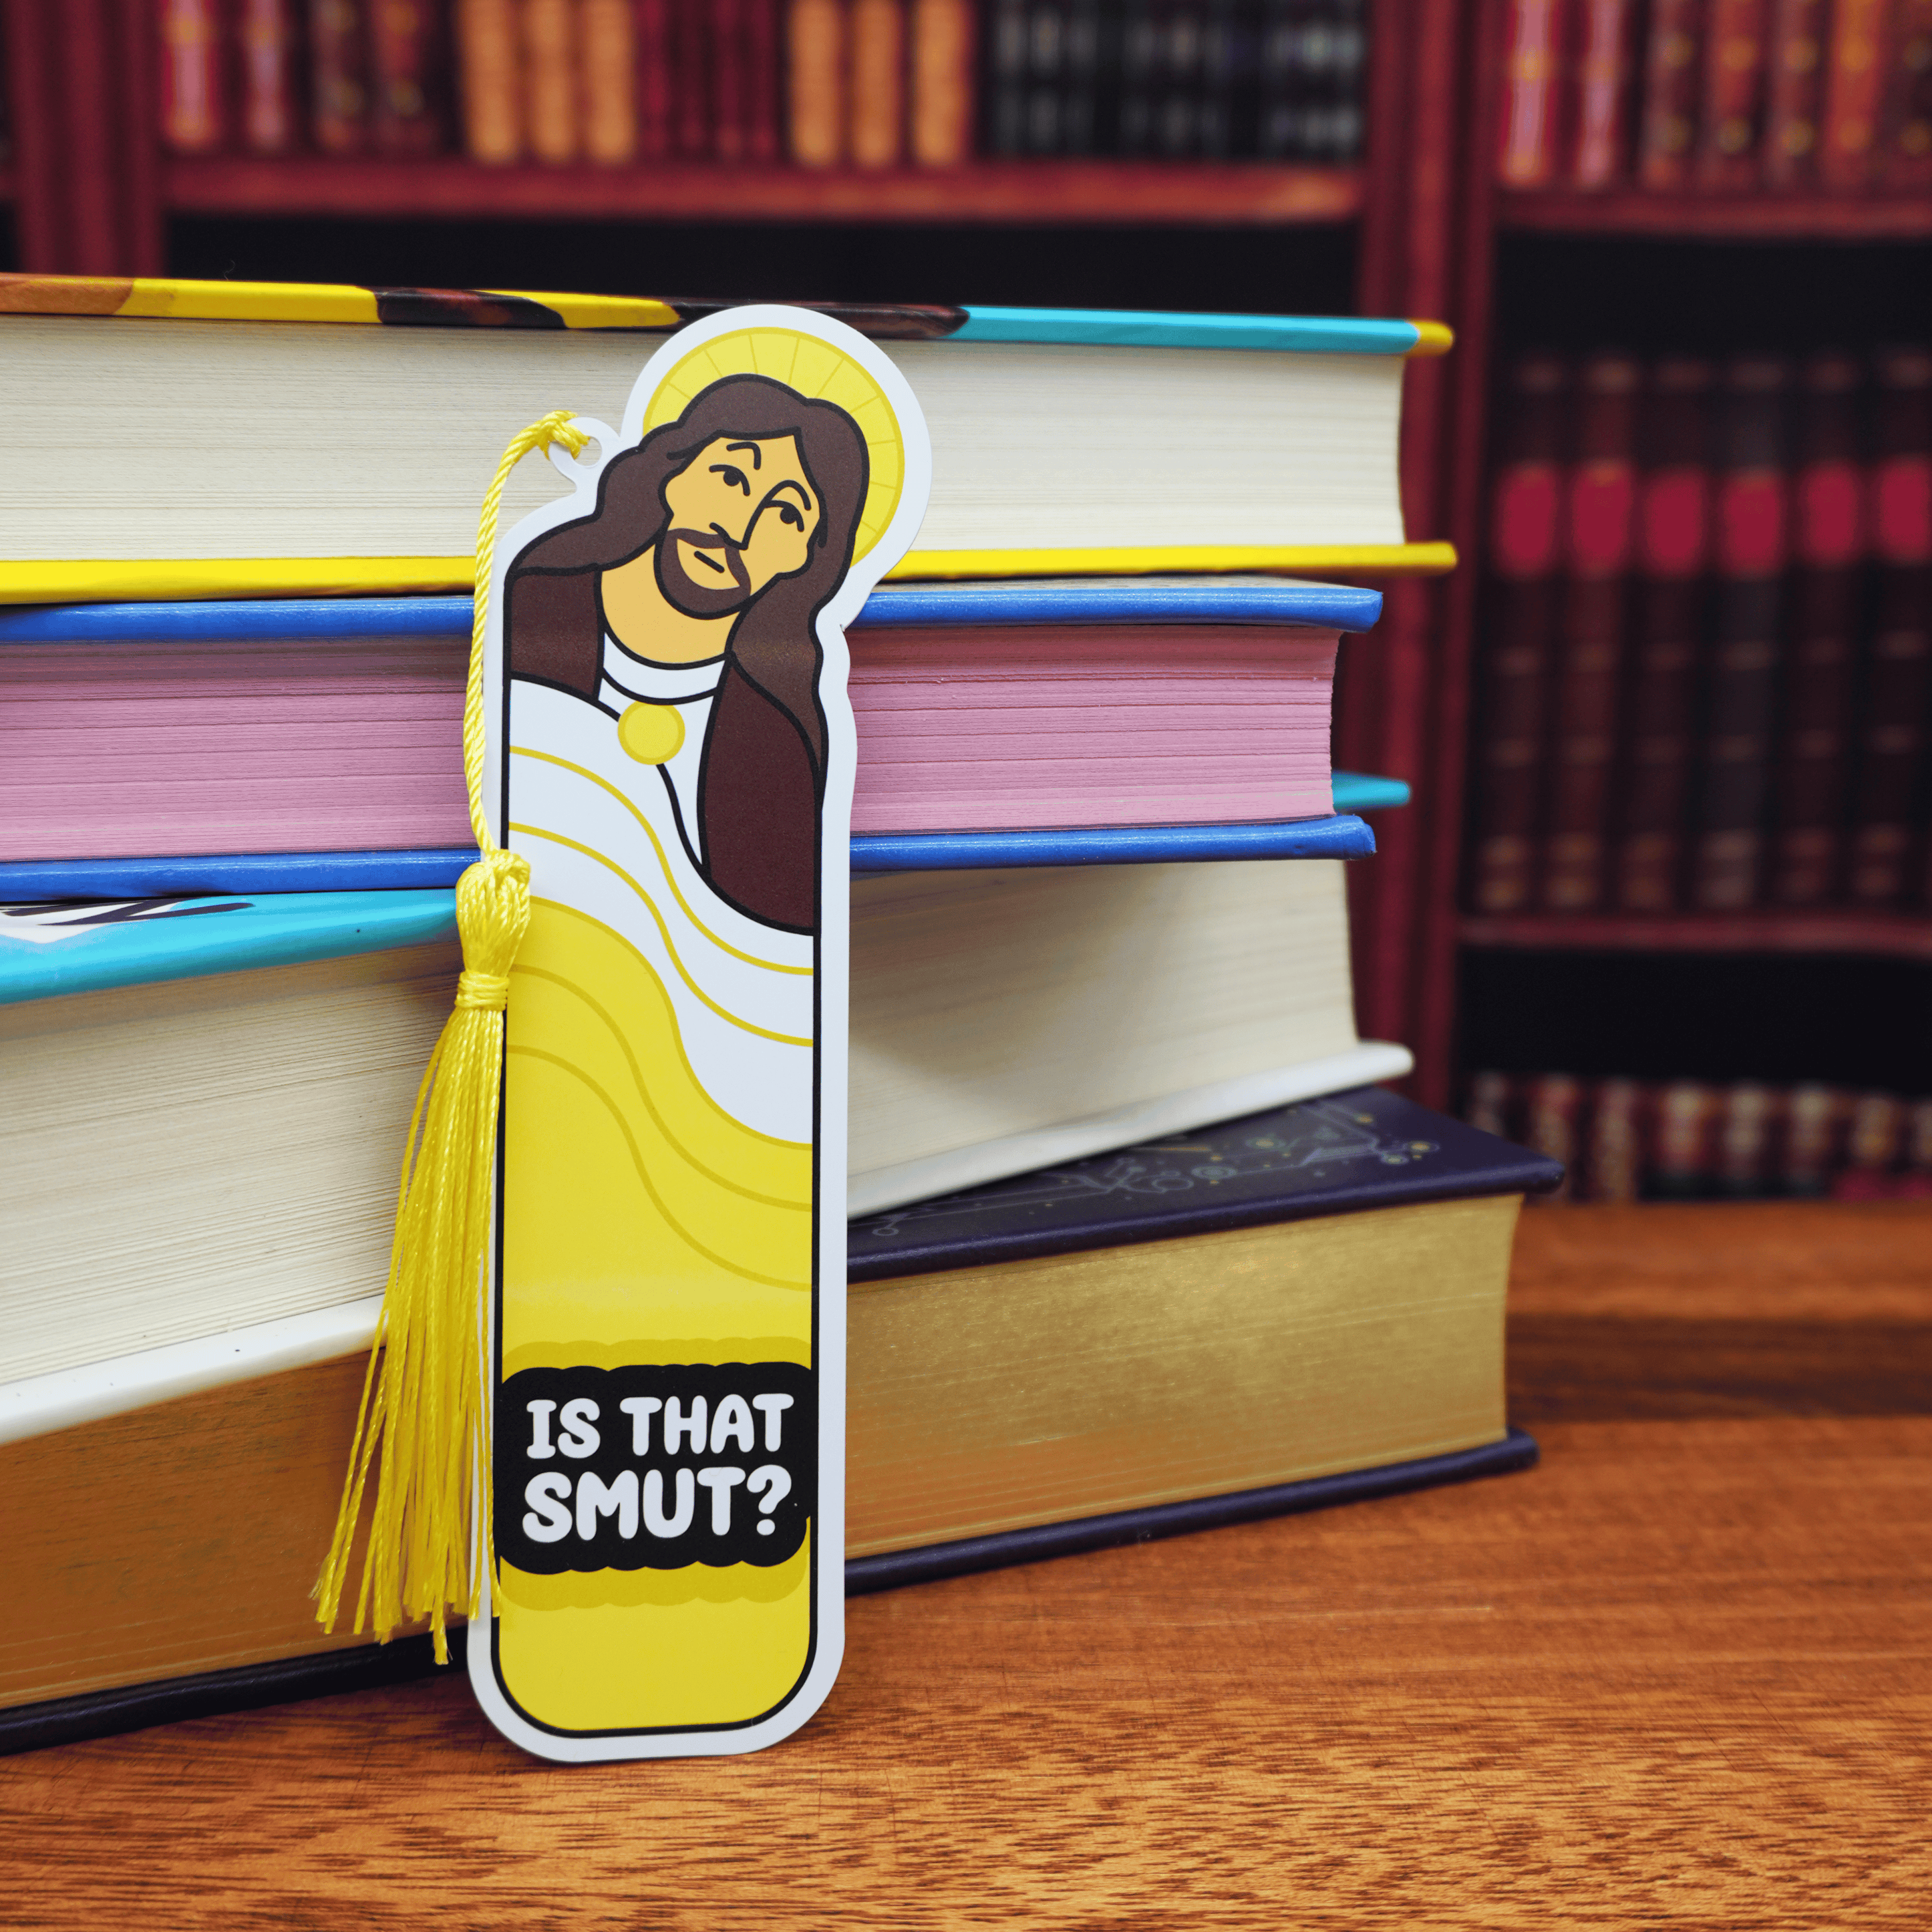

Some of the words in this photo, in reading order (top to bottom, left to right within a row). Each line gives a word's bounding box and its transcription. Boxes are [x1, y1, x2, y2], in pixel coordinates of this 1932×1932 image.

[526, 1398, 601, 1459] IS
[619, 1393, 794, 1456] THAT
[522, 1464, 792, 1543] SMUT?
